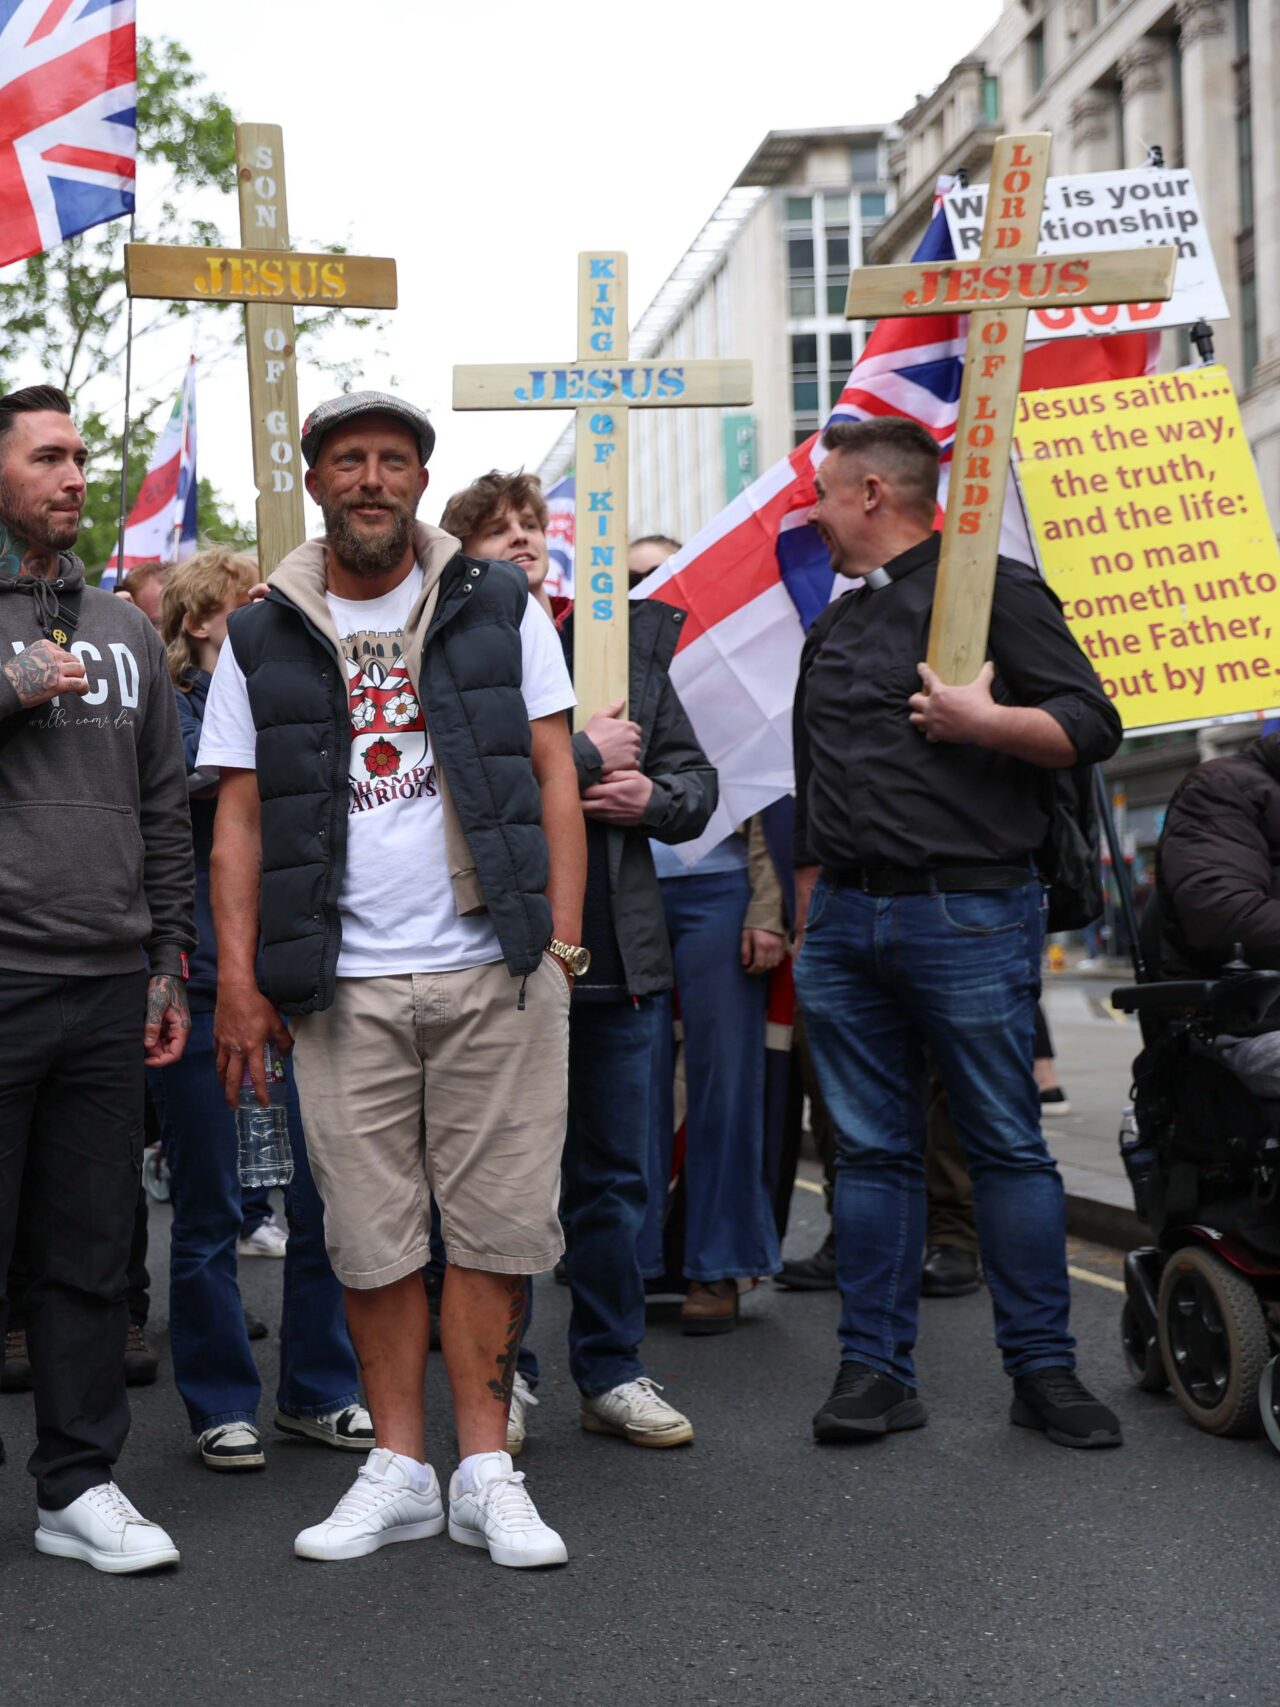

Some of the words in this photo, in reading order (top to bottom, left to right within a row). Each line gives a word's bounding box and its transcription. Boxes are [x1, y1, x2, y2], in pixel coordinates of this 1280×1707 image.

[254, 147, 277, 229] SON
[994, 144, 1031, 249] LORD
[1061, 187, 1094, 209] is
[1107, 177, 1191, 212] your
[959, 208, 1199, 250] Rtionship
[193, 256, 347, 300] JESUS
[902, 260, 1090, 307] JESUS
[589, 259, 615, 352] KING
[263, 328, 287, 383] OF
[981, 321, 1008, 378] OF
[513, 366, 686, 402] JESUS
[1018, 394, 1106, 422] Jesus
[1114, 376, 1230, 410] saith...
[266, 411, 294, 493] GOD
[589, 413, 615, 463] OF
[1013, 437, 1024, 462] I
[1032, 434, 1084, 460] am
[1091, 423, 1148, 453] the
[1156, 413, 1236, 444] way,
[958, 396, 997, 535] LORDS
[1051, 469, 1108, 498] the
[1116, 453, 1216, 489] truth,
[1042, 507, 1108, 541] and
[1114, 502, 1173, 530] the
[1180, 490, 1248, 522] life:
[588, 492, 614, 621] KINGS
[1090, 551, 1134, 576] no
[1143, 539, 1220, 568] man
[1062, 584, 1185, 621] cometh
[1195, 570, 1277, 602] unto
[1082, 633, 1141, 660] the
[1148, 614, 1272, 650] Father,
[1098, 672, 1158, 700] but
[1164, 662, 1206, 696] by
[349, 781, 436, 814] ATRIOTS
